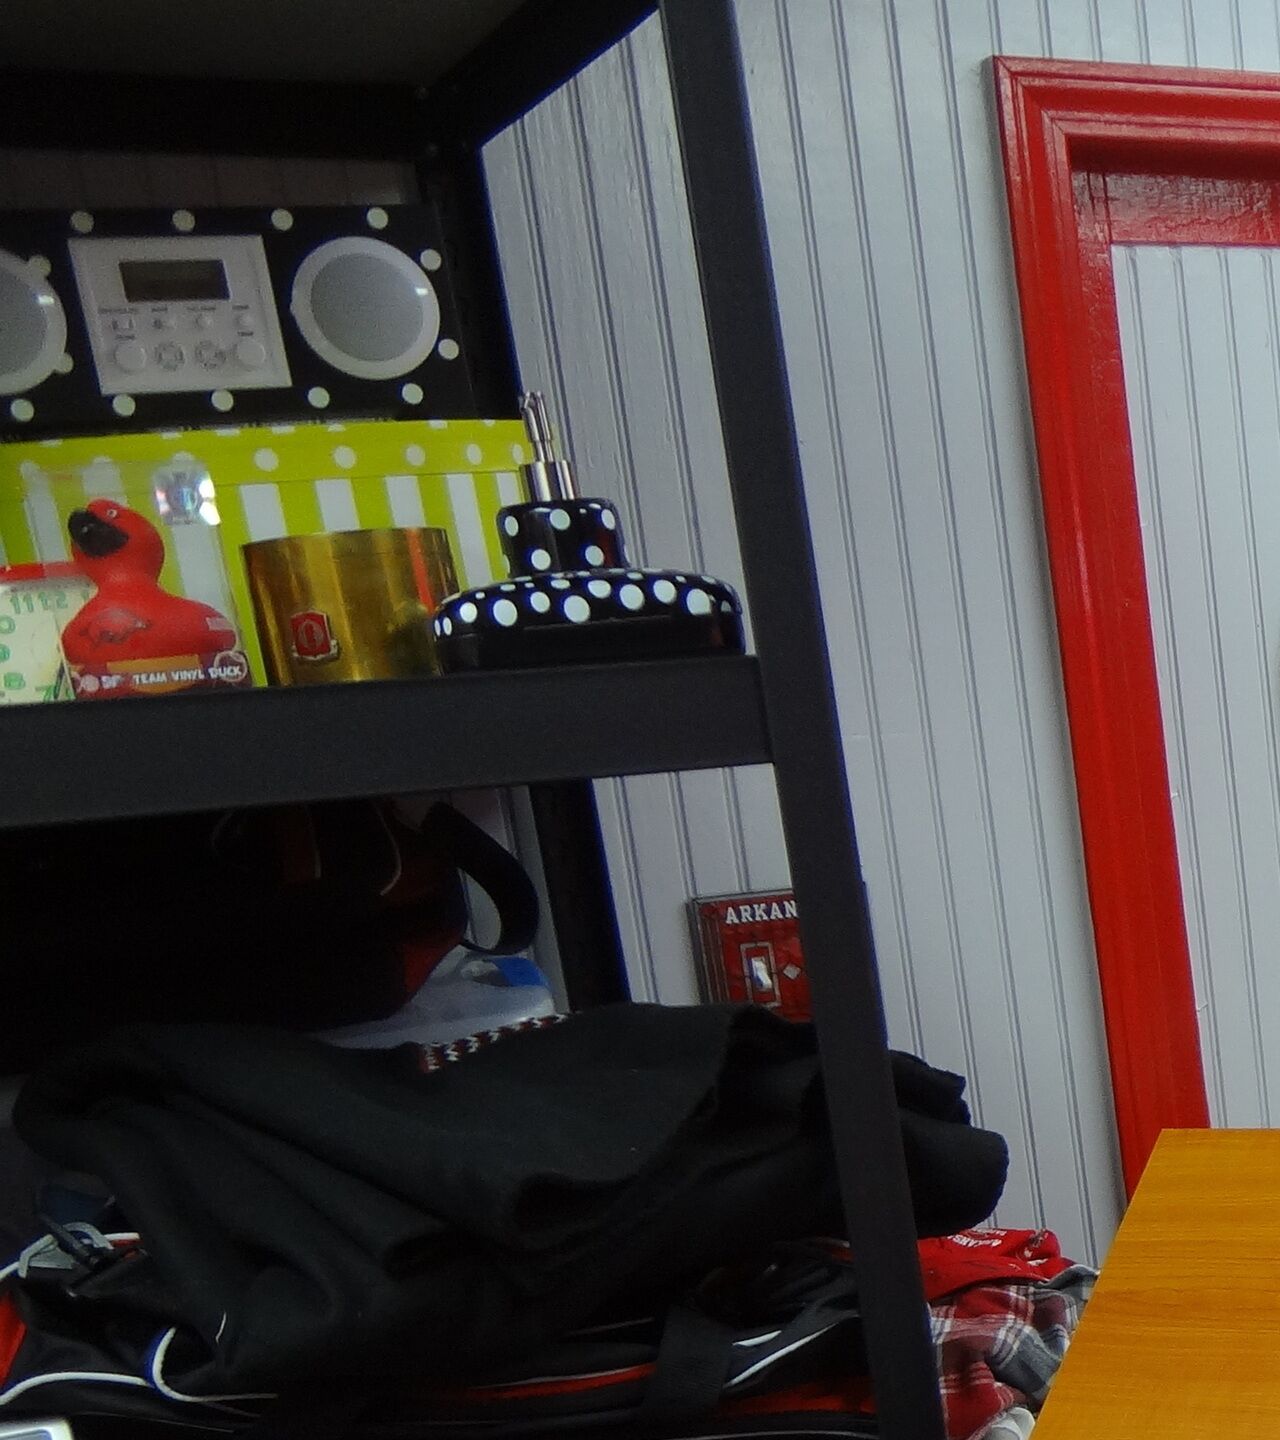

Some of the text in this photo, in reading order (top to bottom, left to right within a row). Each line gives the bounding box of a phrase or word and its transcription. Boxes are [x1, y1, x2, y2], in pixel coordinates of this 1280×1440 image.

[132, 669, 169, 685] TEAM
[170, 663, 205, 681] VINYL
[207, 662, 243, 678] DUCK
